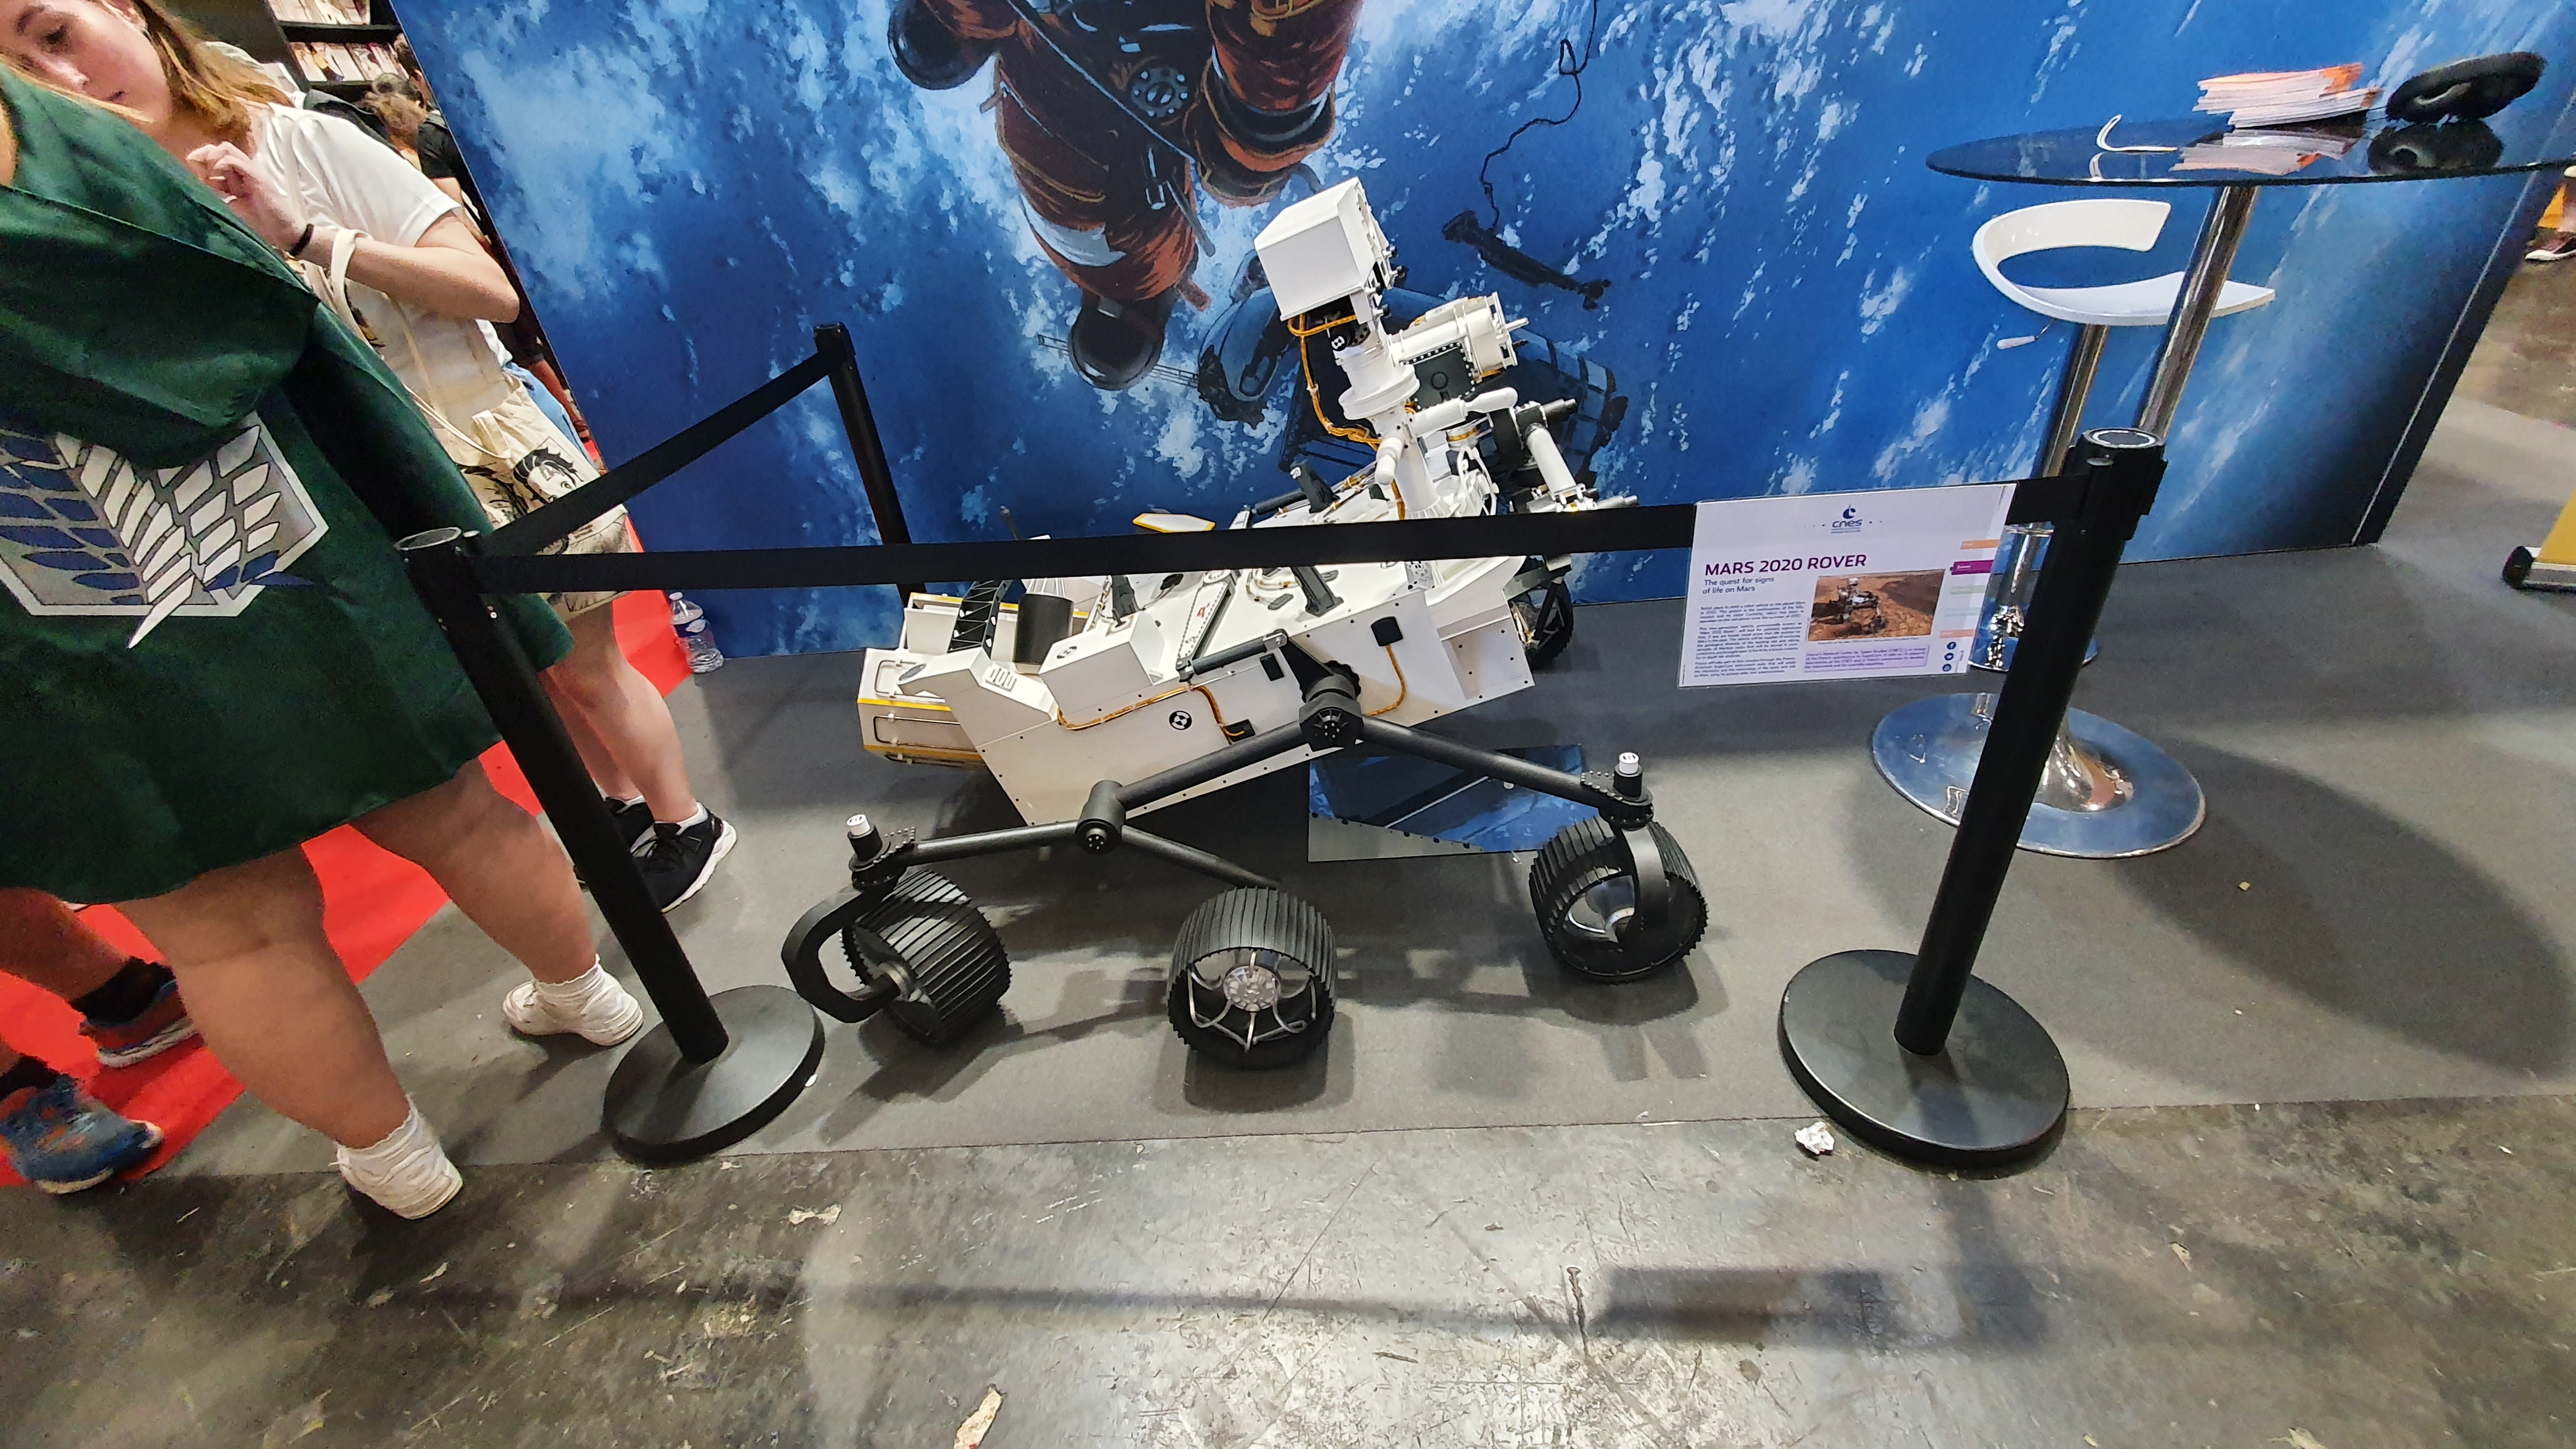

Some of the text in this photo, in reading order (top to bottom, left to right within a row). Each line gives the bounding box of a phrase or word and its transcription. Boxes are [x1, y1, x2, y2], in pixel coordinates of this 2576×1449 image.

[1832, 519, 1863, 528] cnes
[1705, 554, 1867, 576] MARS 2020 ROVER
[1720, 577, 1740, 586] quest
